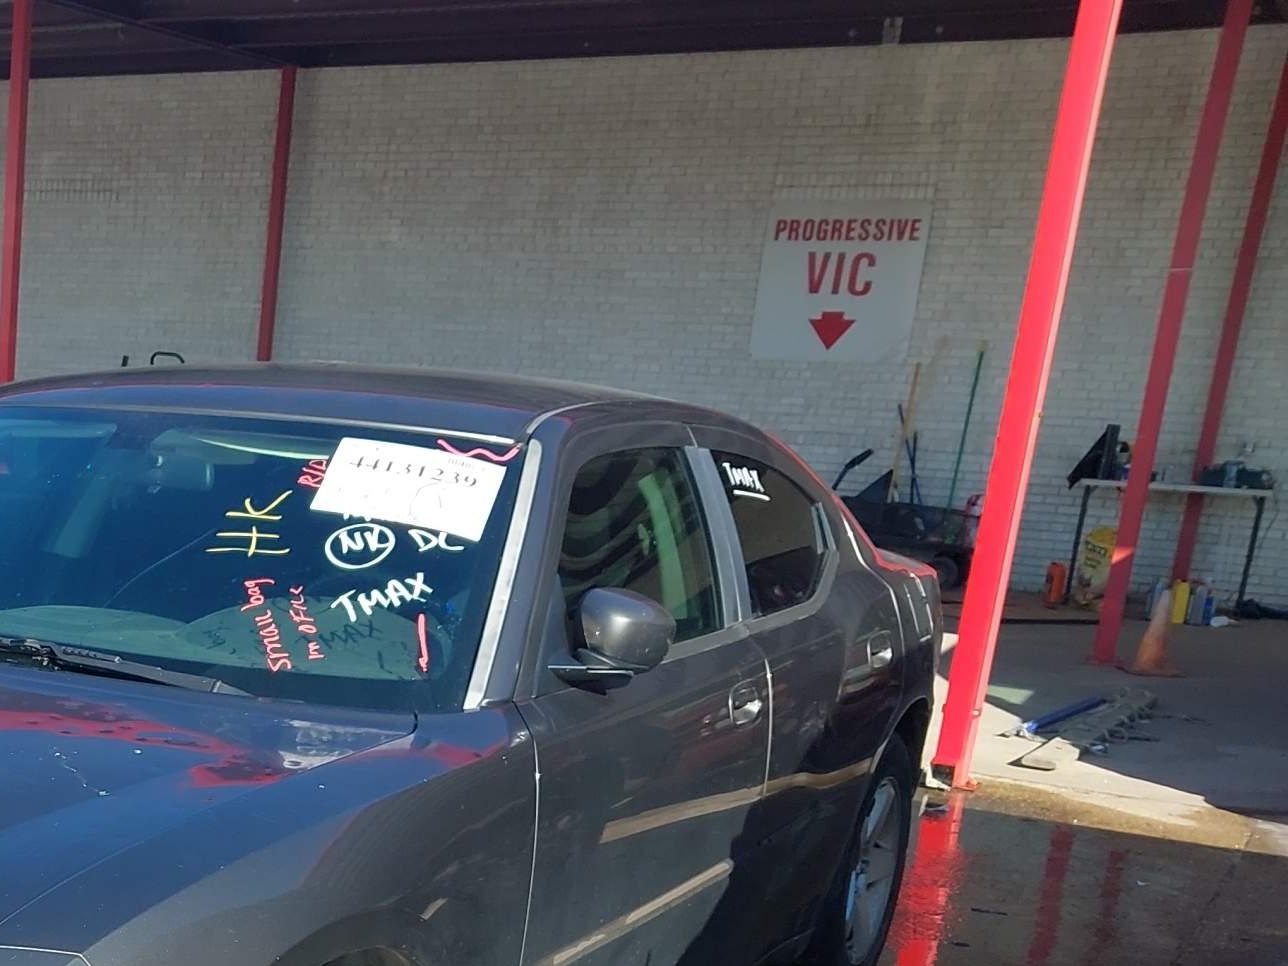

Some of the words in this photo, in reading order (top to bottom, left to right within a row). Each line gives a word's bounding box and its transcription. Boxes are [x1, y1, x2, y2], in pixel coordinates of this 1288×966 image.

[773, 218, 923, 242] PROGRESSIVE
[807, 251, 877, 297] VIC
[349, 455, 479, 488] 44131239
[205, 489, 293, 557] HK
[338, 526, 392, 555] NK
[331, 571, 434, 623] TMAX
